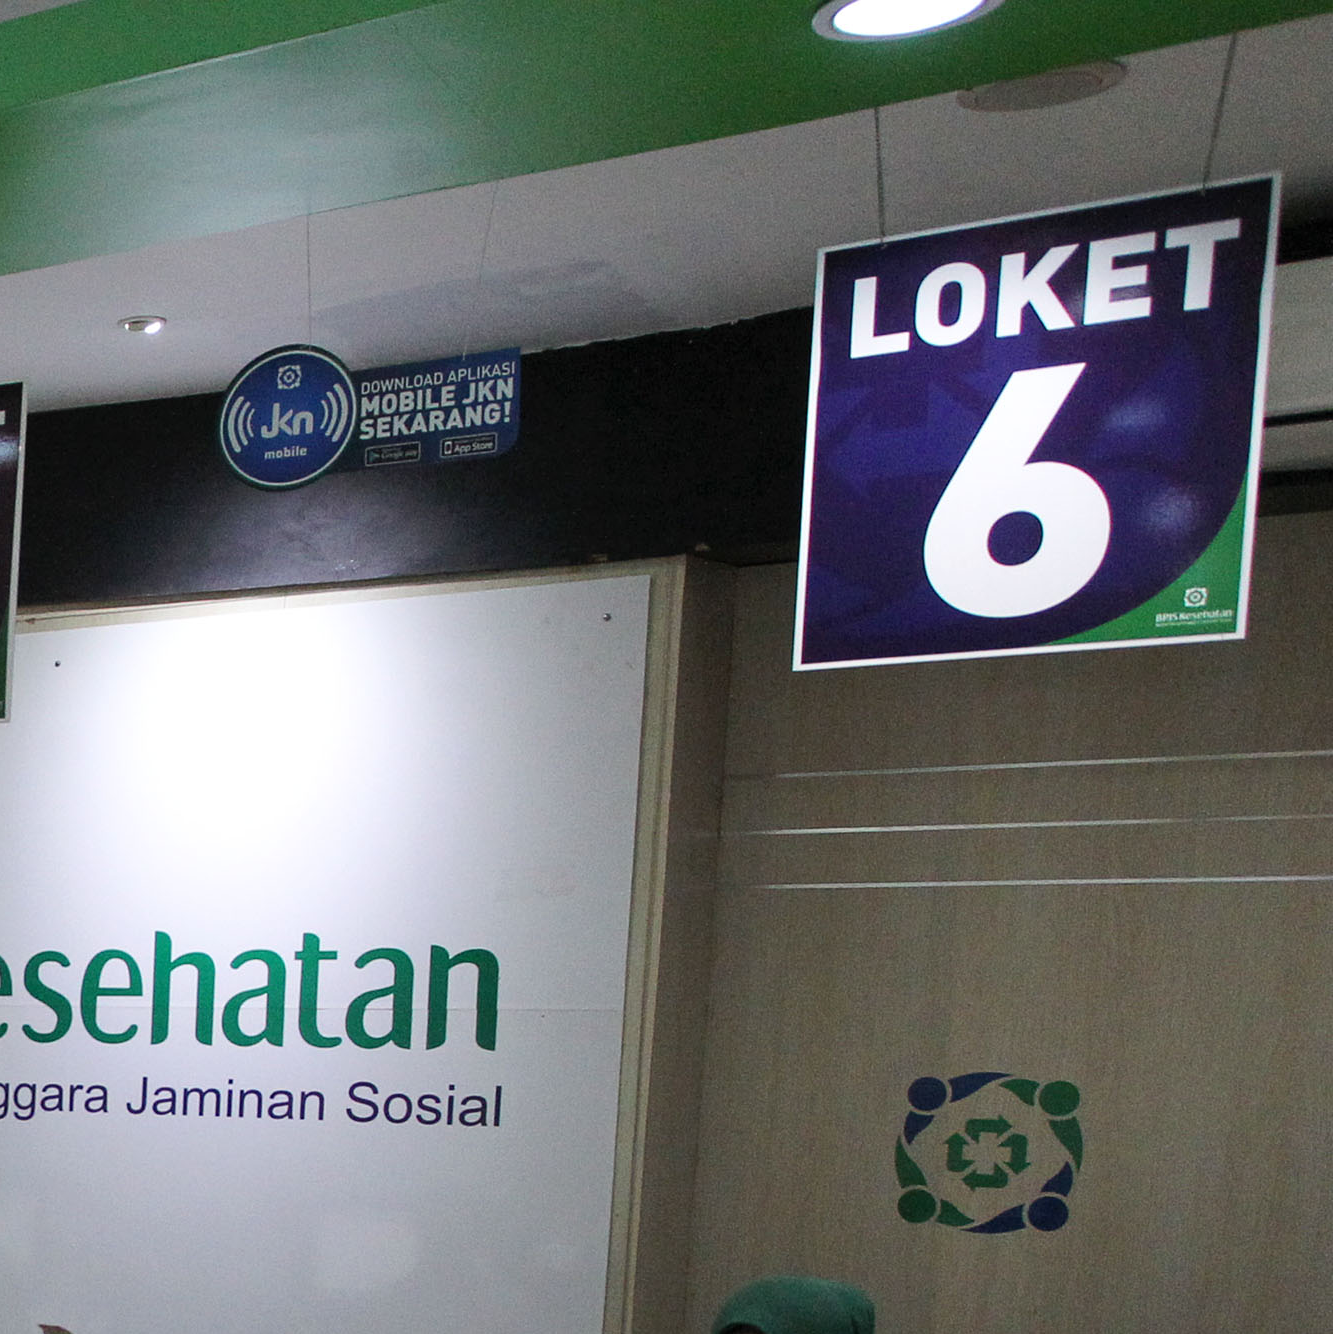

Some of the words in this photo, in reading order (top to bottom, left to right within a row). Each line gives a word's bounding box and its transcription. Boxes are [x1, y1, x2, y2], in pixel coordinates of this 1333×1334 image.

[850, 218, 1241, 359] LOKET
[360, 371, 443, 395] DOWNLOAD
[447, 361, 515, 383] APLIKASI
[360, 385, 456, 416] MOBILE
[462, 377, 514, 403] JKN
[359, 401, 511, 440] SEKARANG!
[264, 446, 307, 460] mobile
[923, 362, 1111, 619] 6
[126, 1076, 325, 1121] Jaminan
[345, 1080, 503, 1127] Sosial
